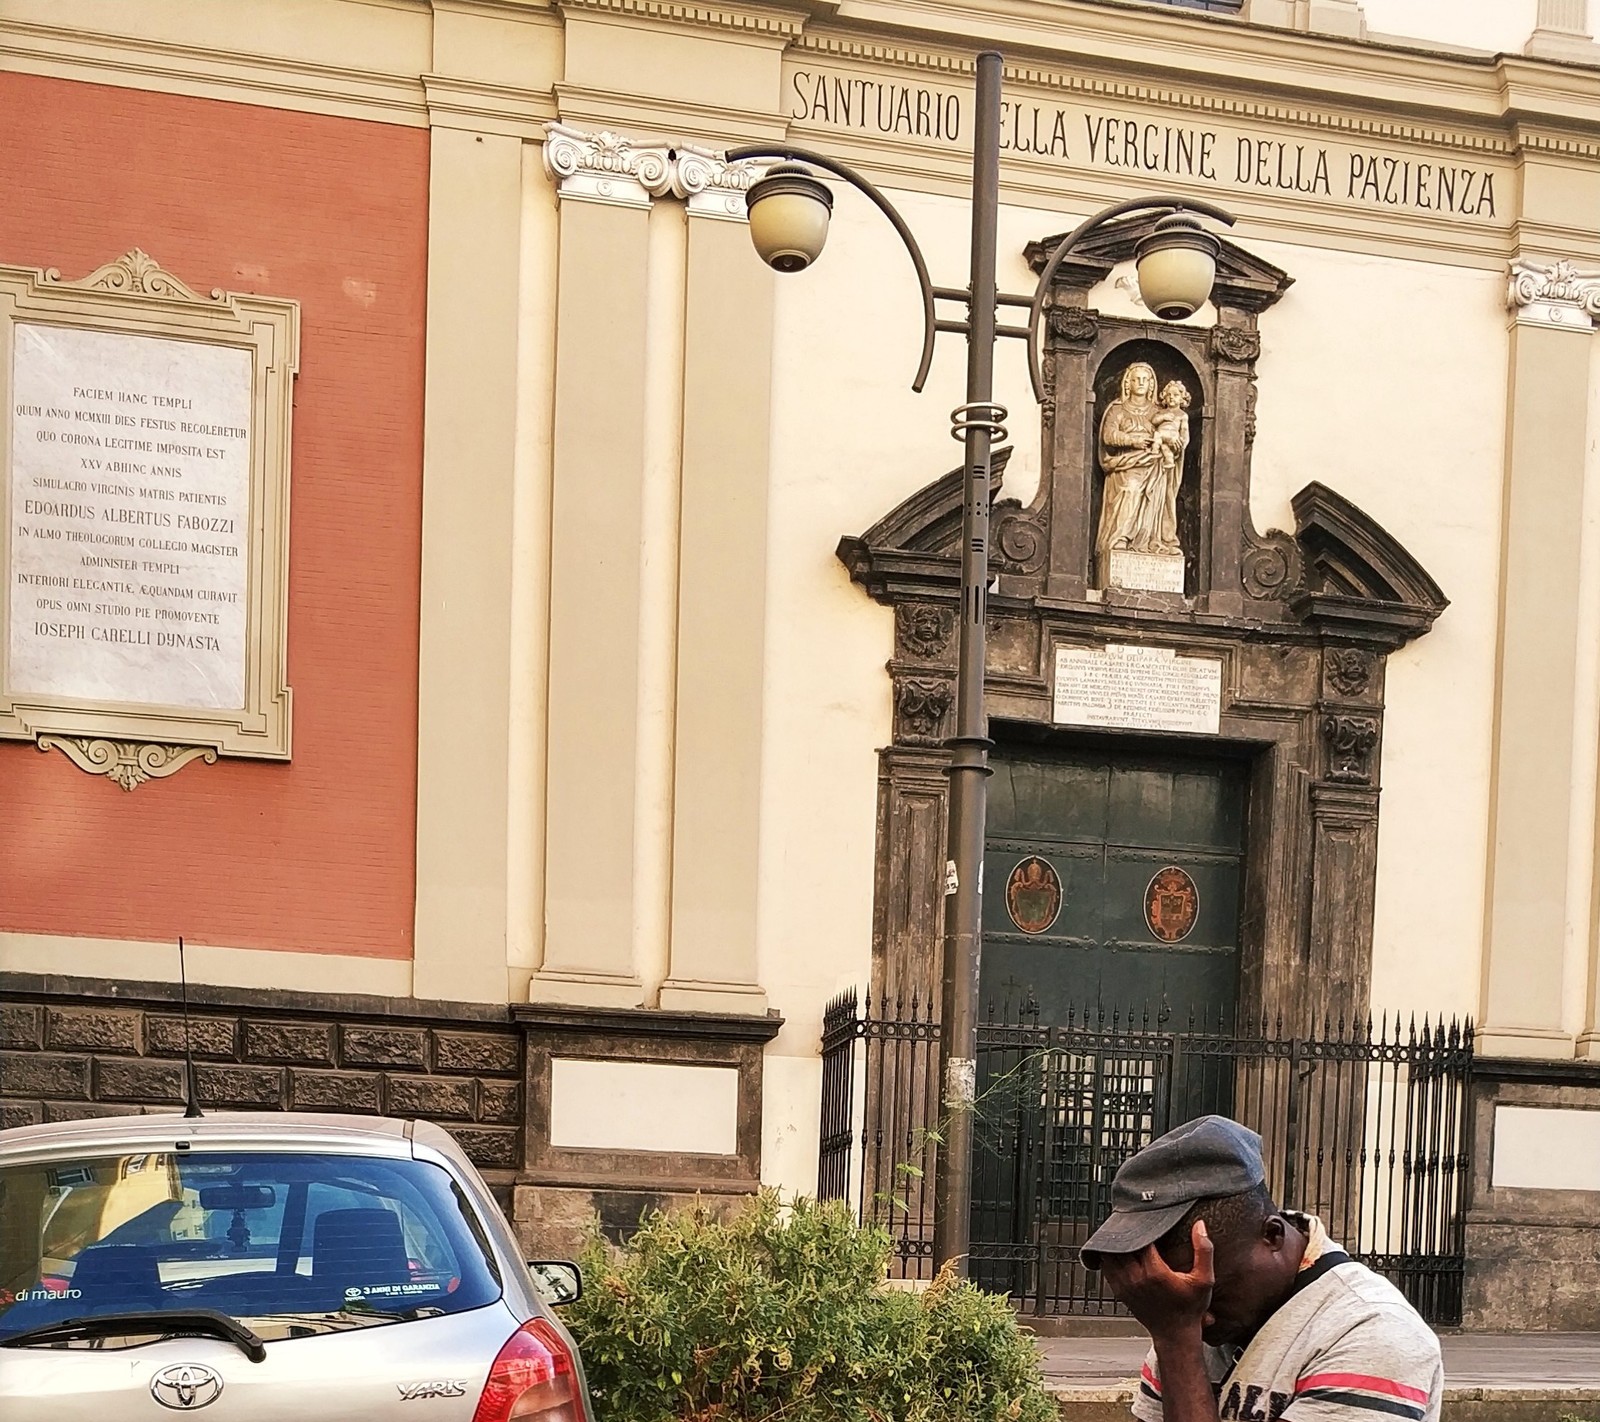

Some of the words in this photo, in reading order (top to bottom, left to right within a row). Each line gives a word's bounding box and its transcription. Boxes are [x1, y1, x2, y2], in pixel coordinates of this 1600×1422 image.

[793, 71, 960, 141] SANTUARIO
[998, 101, 1070, 160] ELLA
[1084, 113, 1218, 181] VERGINE
[1235, 136, 1331, 196] DELLA
[1347, 152, 1496, 218] PAZIENZA
[73, 387, 113, 401] FACIEM
[119, 391, 148, 405] HANC
[152, 396, 192, 410] TEMPLI
[16, 405, 42, 417] QUUM
[45, 408, 70, 420] ANNO
[75, 411, 111, 424] MCMXIII
[115, 415, 136, 427] DIES
[140, 417, 177, 431] FESTUS
[180, 422, 247, 439] RECOLERETUR
[36, 430, 56, 442] QUO
[61, 432, 101, 447] CORONA
[105, 437, 153, 452] LEGITIME
[156, 443, 202, 458] IMPOSITA
[206, 448, 226, 459] EST
[80, 458, 102, 470] XXV
[105, 462, 147, 475] ABHINC
[150, 465, 182, 478] ANNIS
[33, 477, 87, 492] SIMULACRO
[91, 483, 135, 497] VIRGINIS
[139, 488, 175, 501] MATRIS
[179, 491, 227, 506] PATIENTIS
[25, 499, 95, 520] EDOARDUS
[101, 508, 171, 528] ALBERTUS
[177, 514, 234, 534] FABOZZI
[18, 526, 29, 537] IN
[33, 528, 61, 540] ALMO
[66, 531, 135, 548] THEOLOGORUM
[138, 538, 187, 552] COLLEGIO
[191, 543, 238, 557] MAGISTER
[80, 556, 138, 571] ADMINISTER
[142, 561, 180, 575] TEMPLI
[18, 573, 69, 588] INTERIORI
[197, 590, 238, 603] CURAVIT
[36, 598, 62, 611] OPUS
[66, 601, 91, 613] OMNI
[95, 604, 131, 616] STUDIO
[135, 607, 151, 618] PIE
[155, 609, 220, 625] PROMOVENTE
[35, 621, 85, 640] IOSEPH
[91, 627, 150, 645] CARELLI
[157, 632, 220, 651] DYNASTA
[15, 1288, 29, 1302] di
[32, 1288, 82, 1301] mauro
[363, 1286, 371, 1295] 3
[371, 1286, 391, 1294] ANNI
[402, 1283, 440, 1291] GARANZIA
[396, 1379, 468, 1401] YARIS
